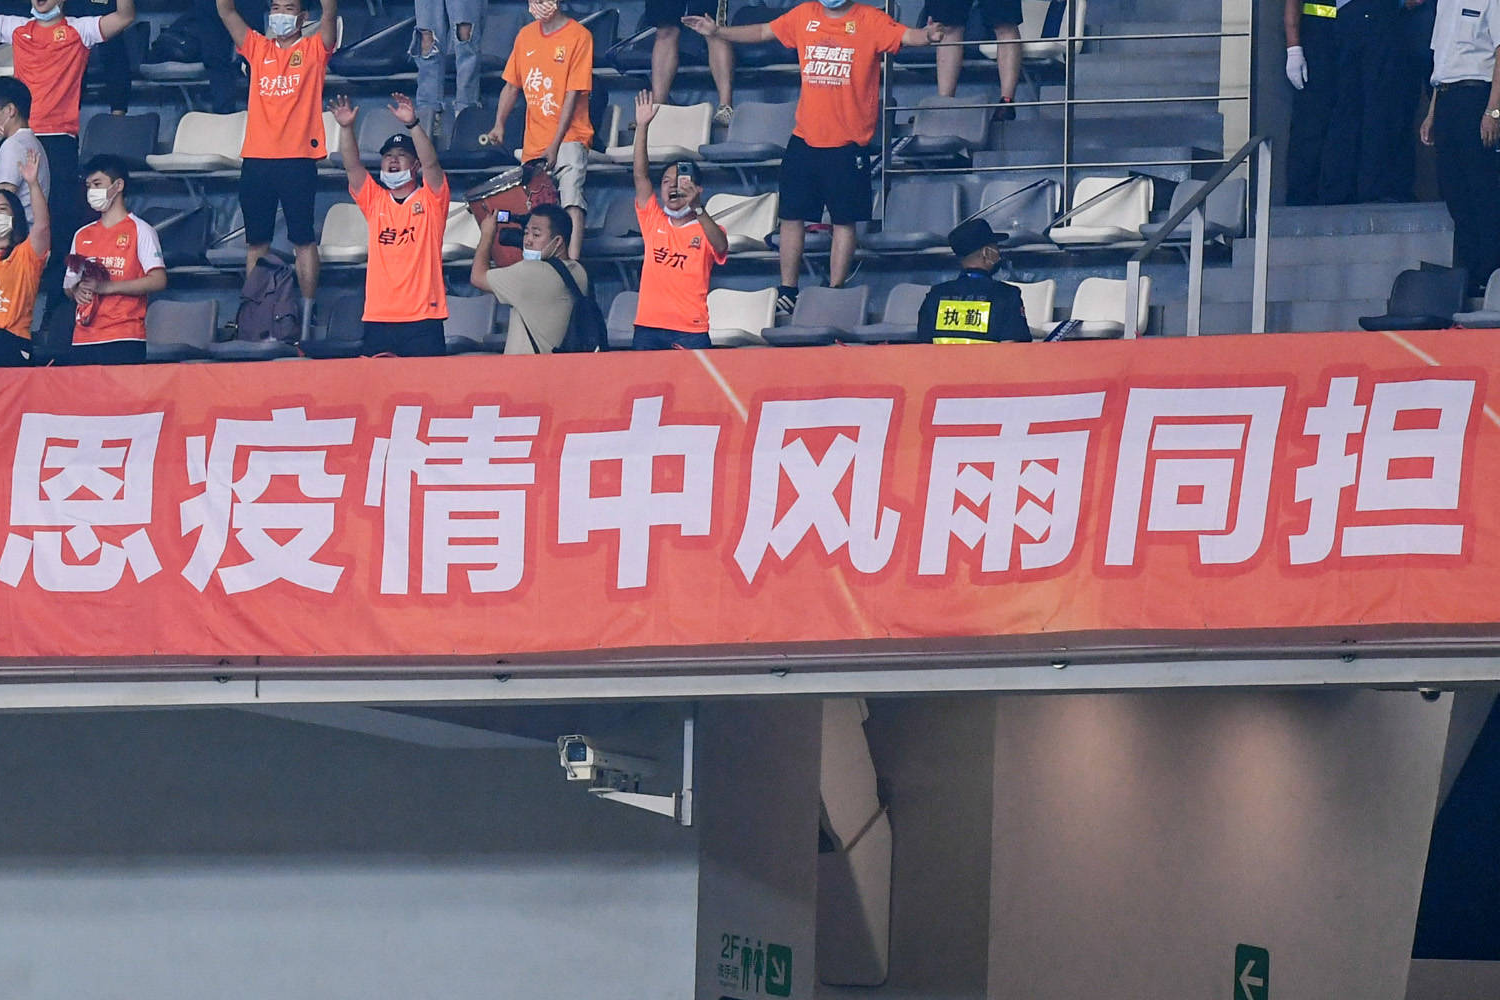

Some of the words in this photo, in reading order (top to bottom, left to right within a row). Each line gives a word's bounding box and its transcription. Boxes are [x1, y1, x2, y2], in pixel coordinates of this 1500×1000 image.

[806, 20, 820, 32] 12
[653, 247, 688, 270] 卓尔
[943, 308, 981, 327] 执勤
[721, 933, 741, 960] 2F
